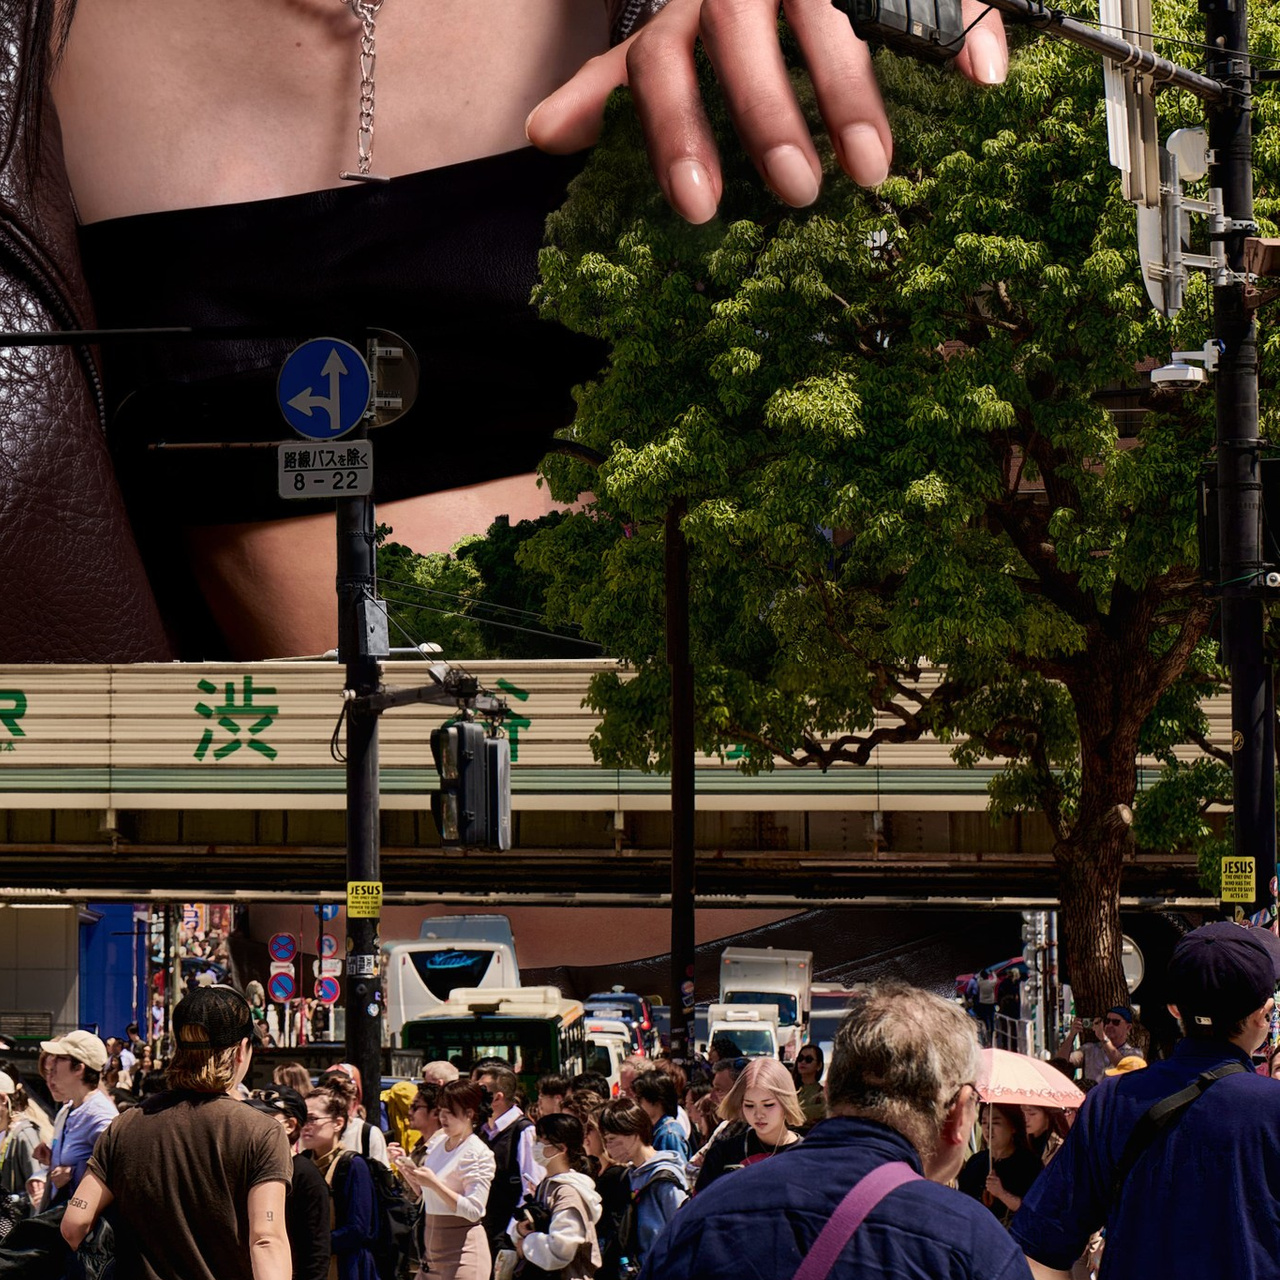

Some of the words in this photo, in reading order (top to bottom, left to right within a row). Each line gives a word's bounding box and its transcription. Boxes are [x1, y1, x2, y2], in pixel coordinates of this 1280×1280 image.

[284, 448, 368, 469] 路線バスを除く
[1223, 861, 1253, 874] JESUS
[349, 885, 381, 895] JESUS
